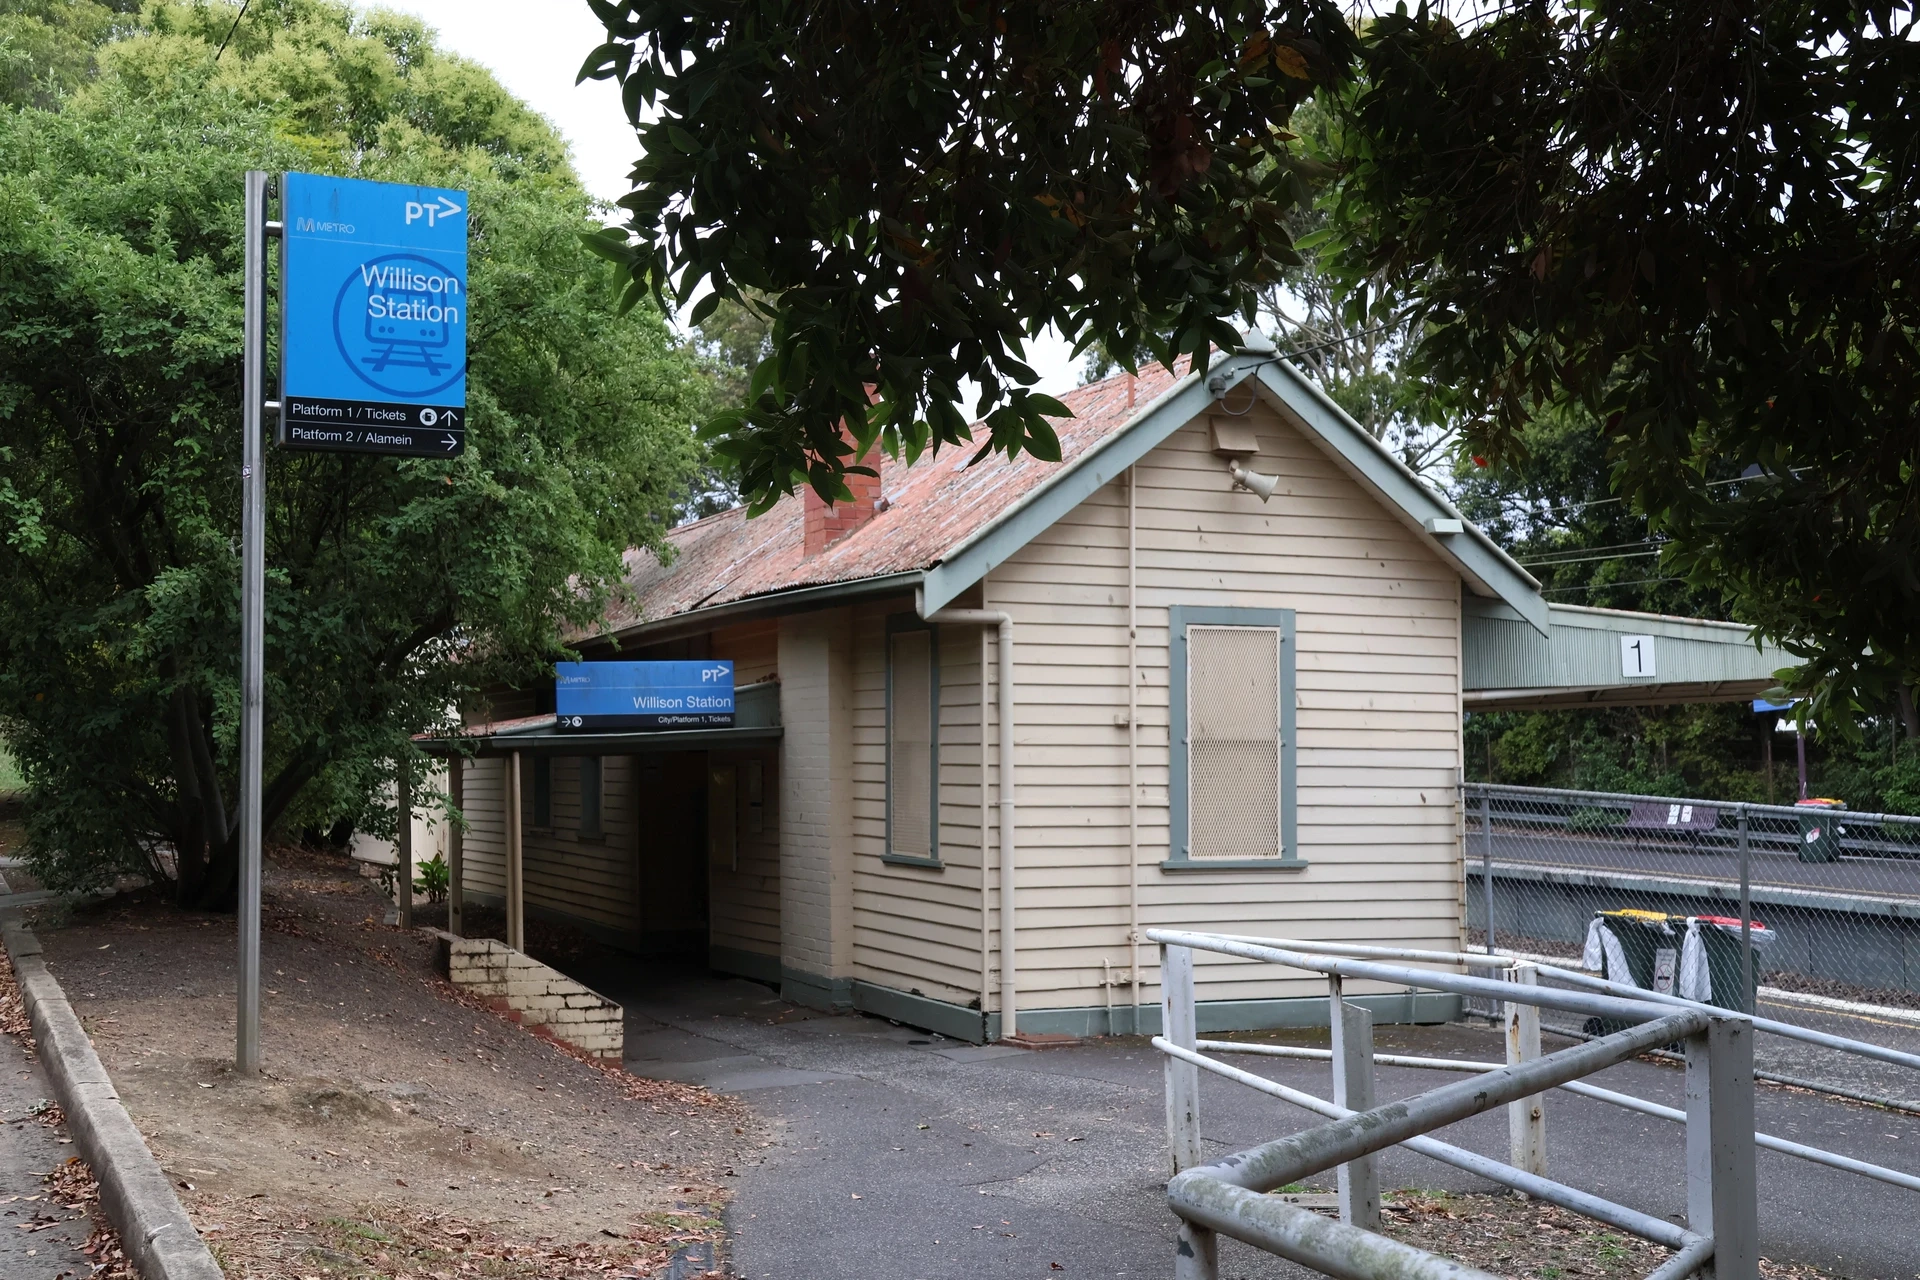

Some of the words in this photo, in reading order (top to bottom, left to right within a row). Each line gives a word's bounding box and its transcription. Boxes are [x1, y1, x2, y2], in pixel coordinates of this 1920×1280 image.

[316, 222, 356, 234] METRO
[361, 263, 459, 295] Willison
[368, 294, 459, 324] Station
[292, 403, 343, 417] Platform
[346, 407, 353, 418] 1
[365, 407, 407, 421] Tickets
[292, 427, 342, 442] Platform
[345, 431, 354, 443] 2
[365, 432, 412, 445] Alamein
[1630, 639, 1642, 673] 1
[633, 696, 683, 709] Willison
[686, 695, 731, 708] Station
[658, 715, 700, 725] City/Platform
[708, 715, 731, 723] Tickets
